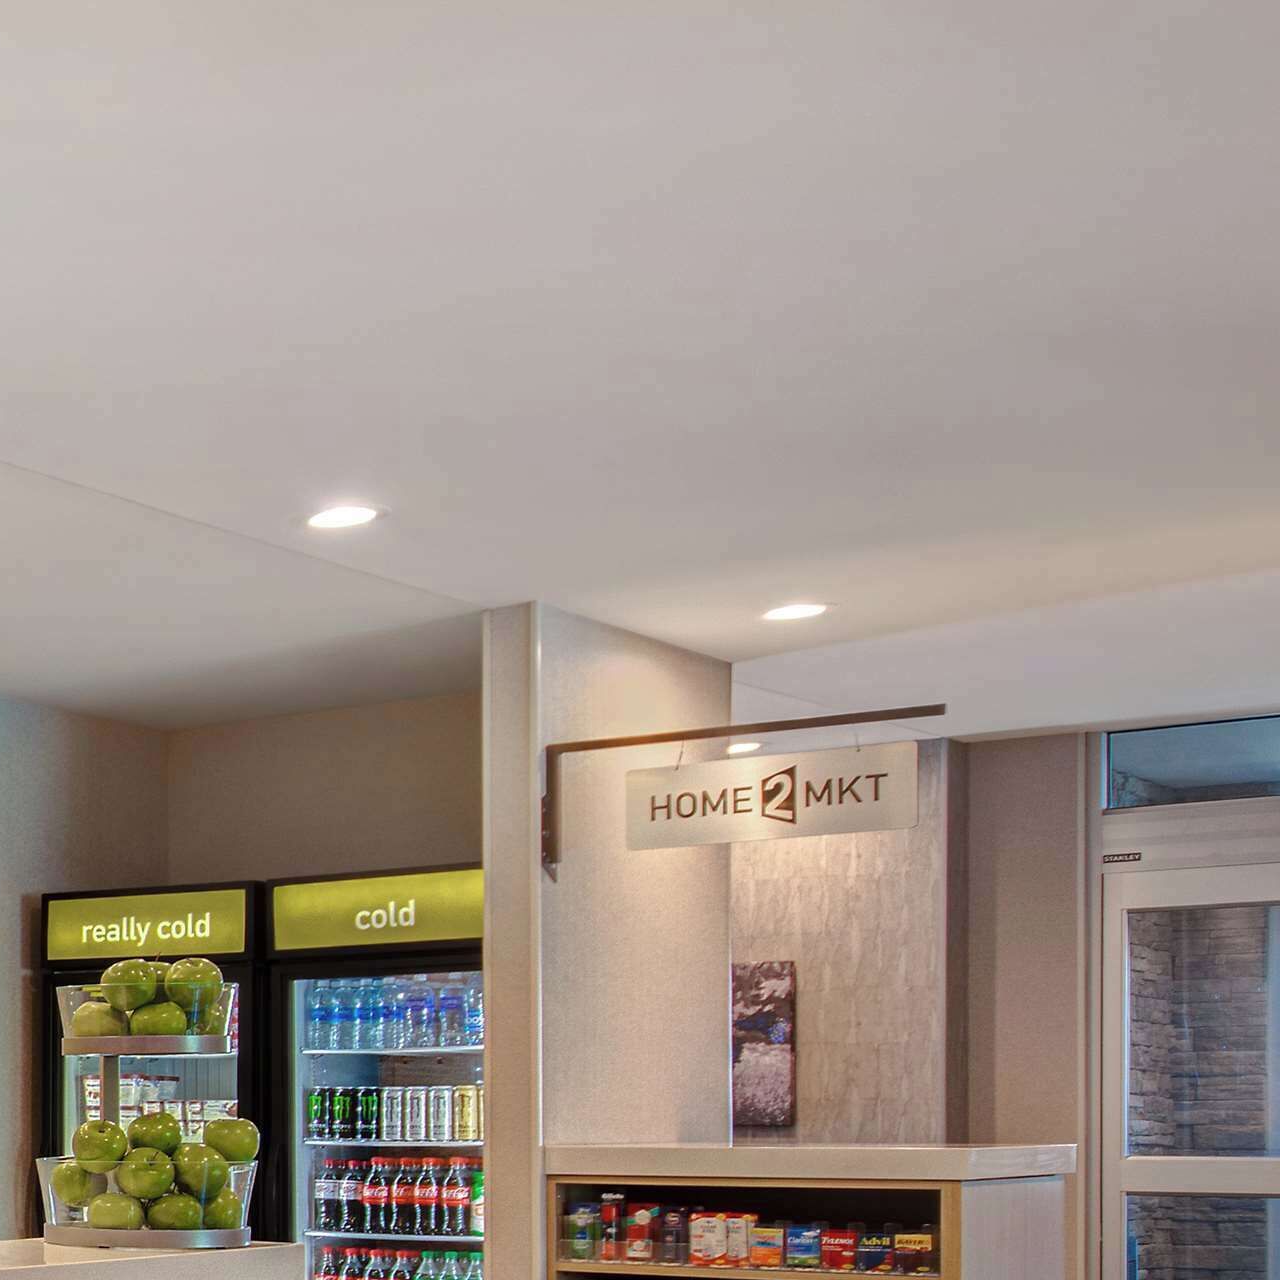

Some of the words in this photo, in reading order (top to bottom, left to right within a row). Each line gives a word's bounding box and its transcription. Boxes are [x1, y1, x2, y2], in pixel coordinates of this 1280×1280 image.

[650, 786, 753, 821] HOME
[805, 772, 889, 808] MKT
[1104, 854, 1139, 862] STANLEY
[82, 917, 151, 946] really
[157, 913, 211, 939] cold
[355, 900, 416, 930] cold
[860, 1237, 890, 1246] Advil
